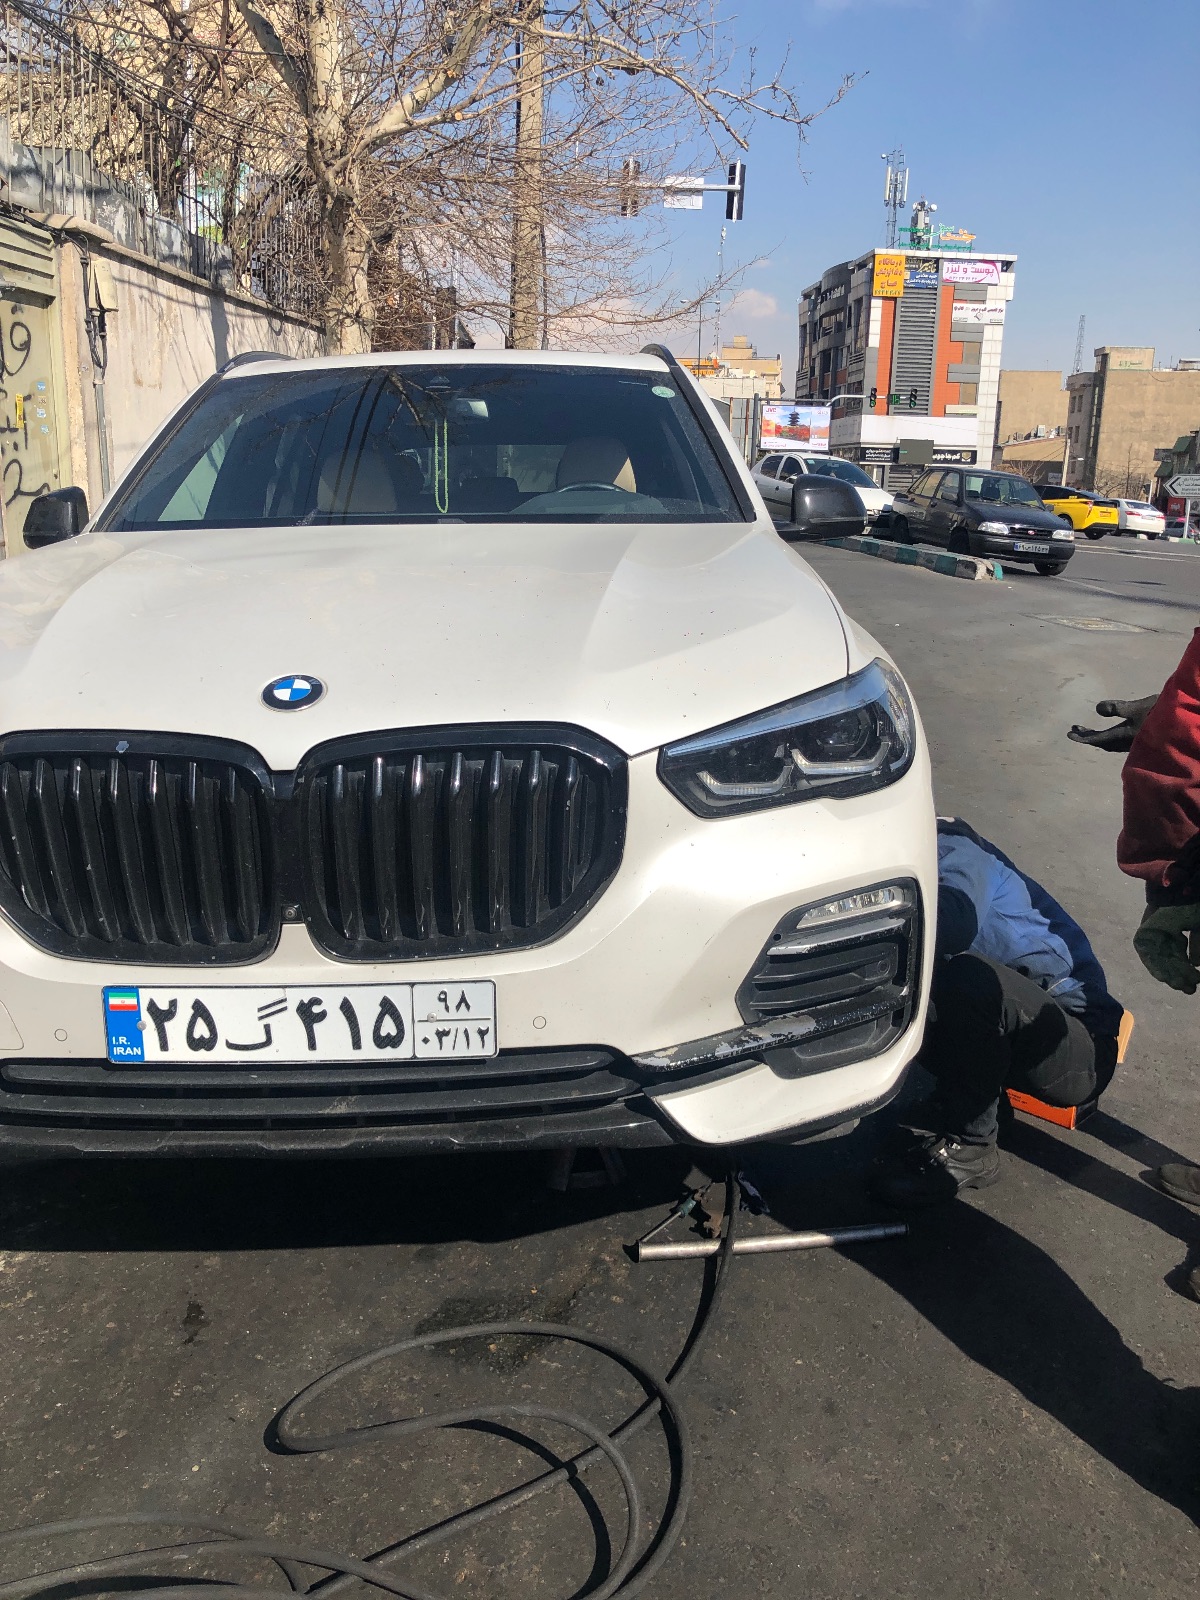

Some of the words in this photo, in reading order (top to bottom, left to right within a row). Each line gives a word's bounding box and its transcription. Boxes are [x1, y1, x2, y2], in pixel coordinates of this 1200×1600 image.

[878, 258, 903, 267] درمانگاه
[876, 267, 903, 278] دندانپزشکی
[945, 265, 960, 274] لیزر
[970, 266, 995, 278] پوست
[436, 989, 472, 1013] ۹۸
[146, 997, 219, 1052] ۲۵
[295, 995, 406, 1052] ۴۱۵
[112, 1036, 130, 1044] I.R.
[421, 1026, 490, 1051] ۰۳/۱۲
[113, 1046, 141, 1056] IRAN
